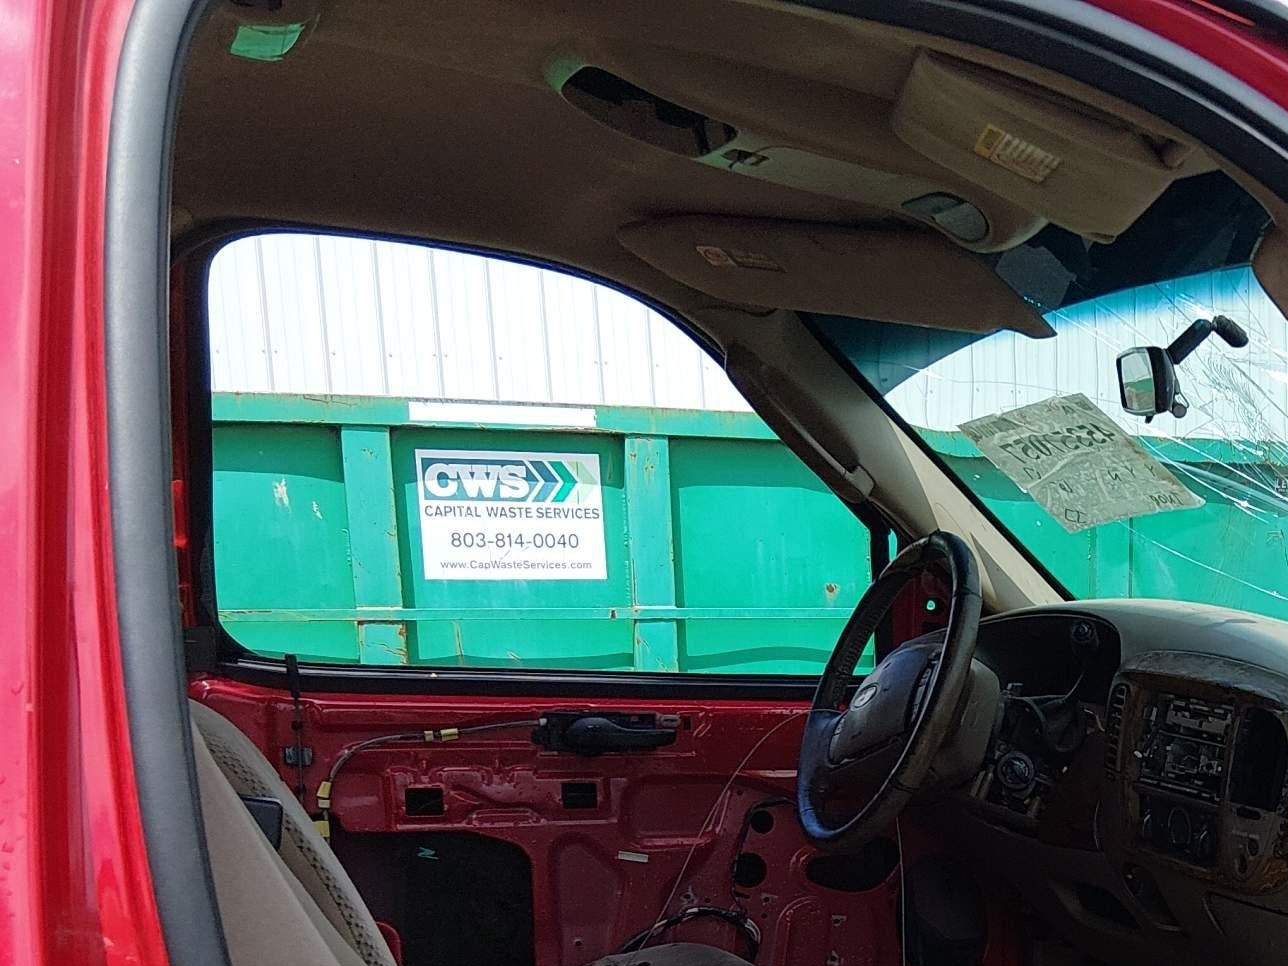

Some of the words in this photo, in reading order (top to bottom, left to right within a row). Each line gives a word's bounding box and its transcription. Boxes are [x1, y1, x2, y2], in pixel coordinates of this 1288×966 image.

[424, 462, 527, 499] CWS
[424, 505, 481, 518] CAPITAL
[486, 506, 532, 519] WASTE
[536, 507, 600, 520] SERVICES
[451, 532, 579, 549] 803-814-0040
[440, 560, 592, 570] www.CapWasteServices.com
